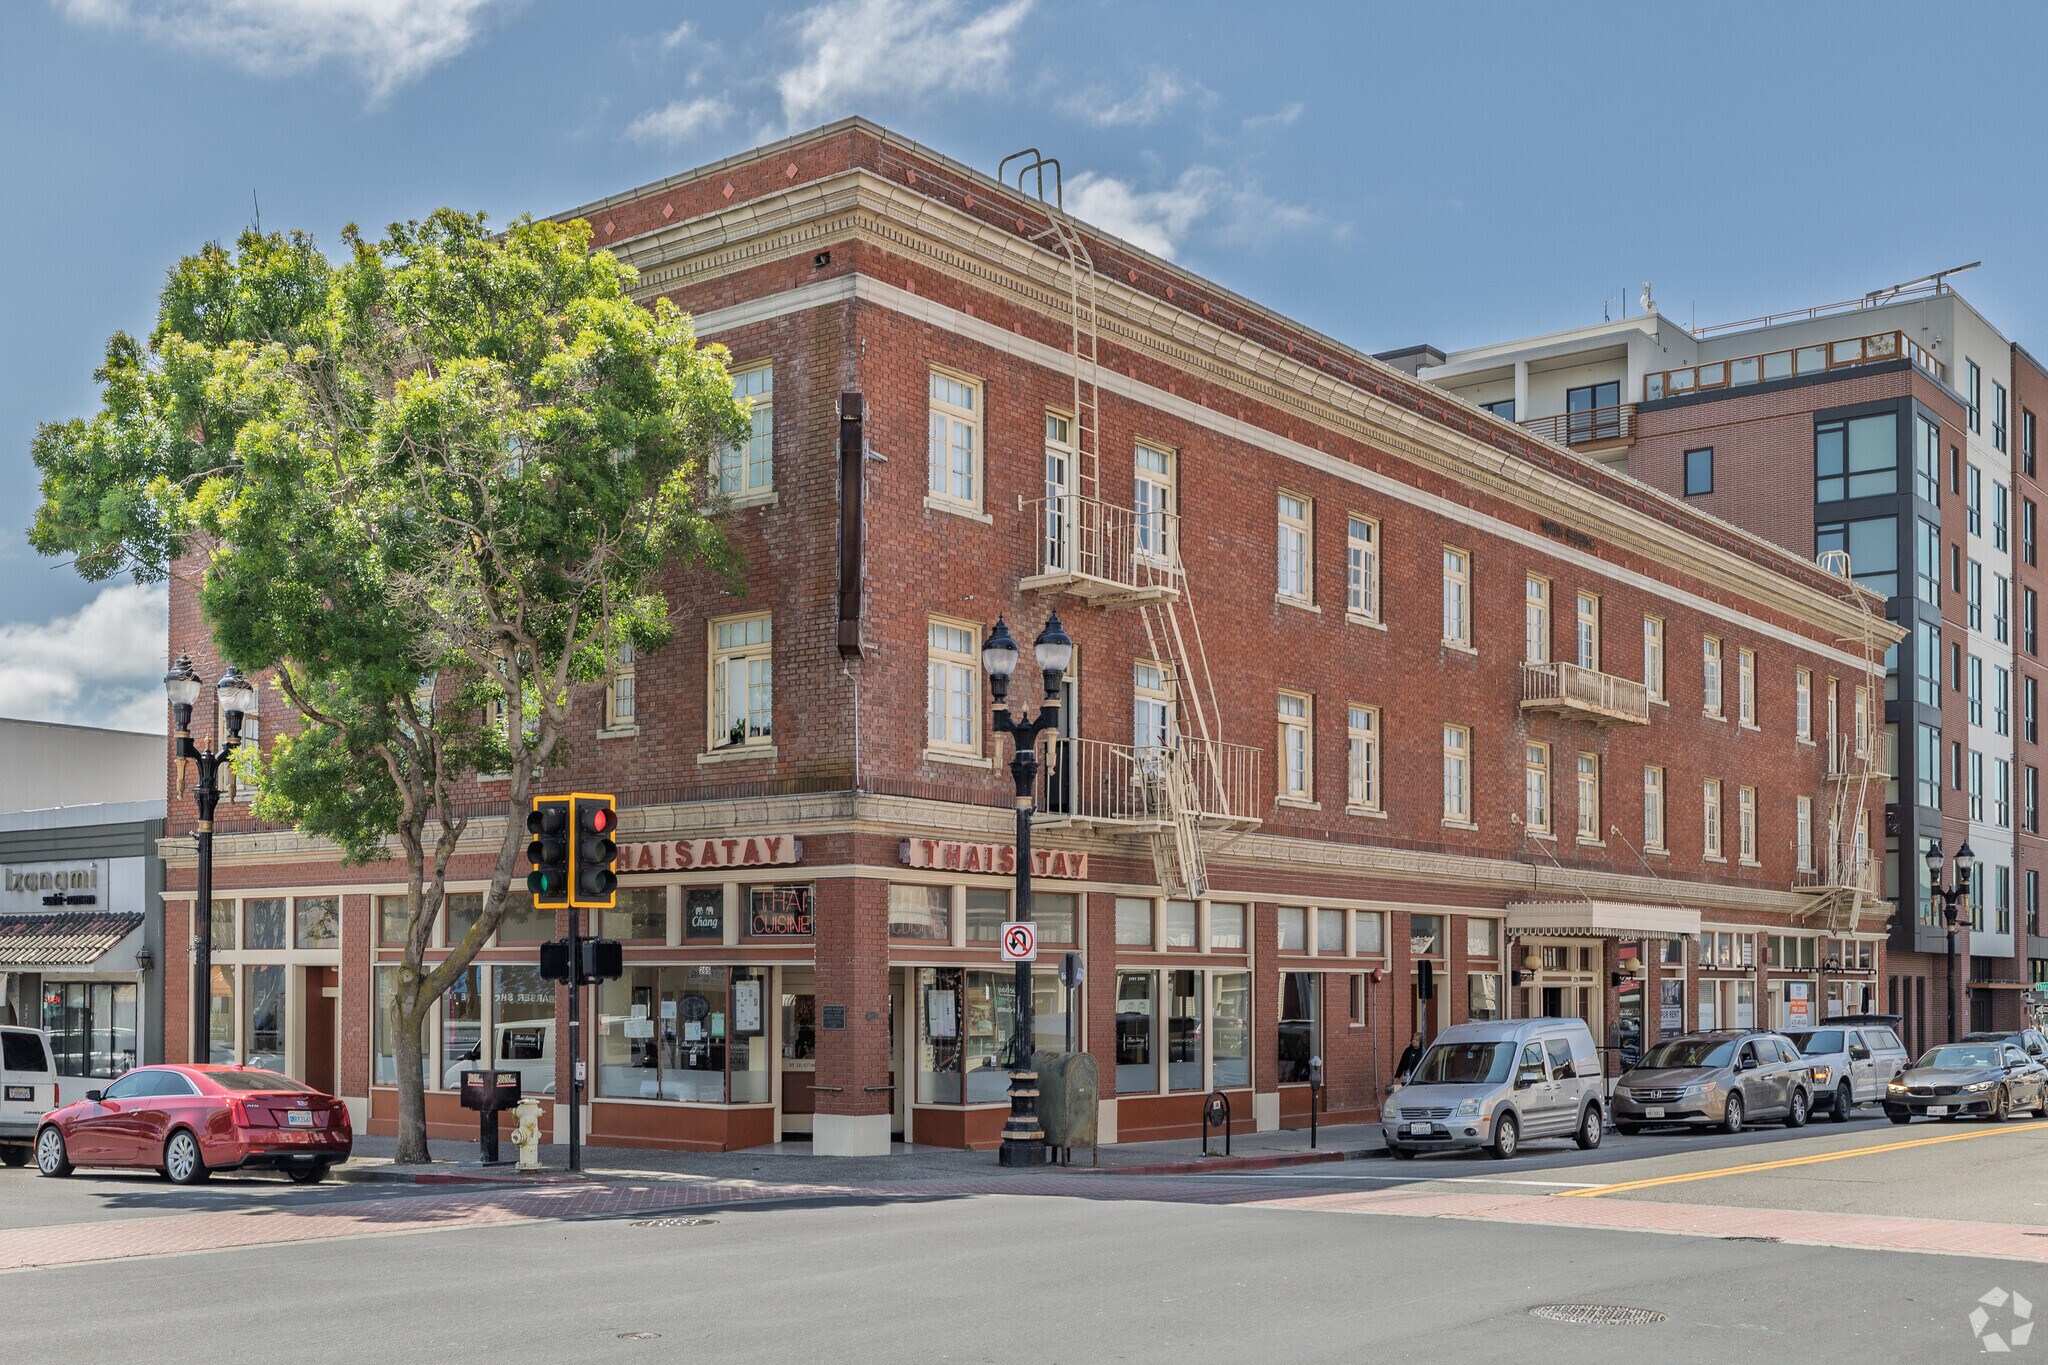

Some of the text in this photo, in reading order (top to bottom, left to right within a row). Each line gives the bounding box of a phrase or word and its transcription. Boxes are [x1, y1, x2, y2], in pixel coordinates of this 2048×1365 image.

[616, 837, 781, 869] HAISATAY
[923, 840, 1085, 877] THAISTAY
[5, 862, 98, 892] Izanami
[758, 889, 808, 912] THAI
[692, 915, 718, 929] Chang
[753, 915, 811, 934] CUISINE
